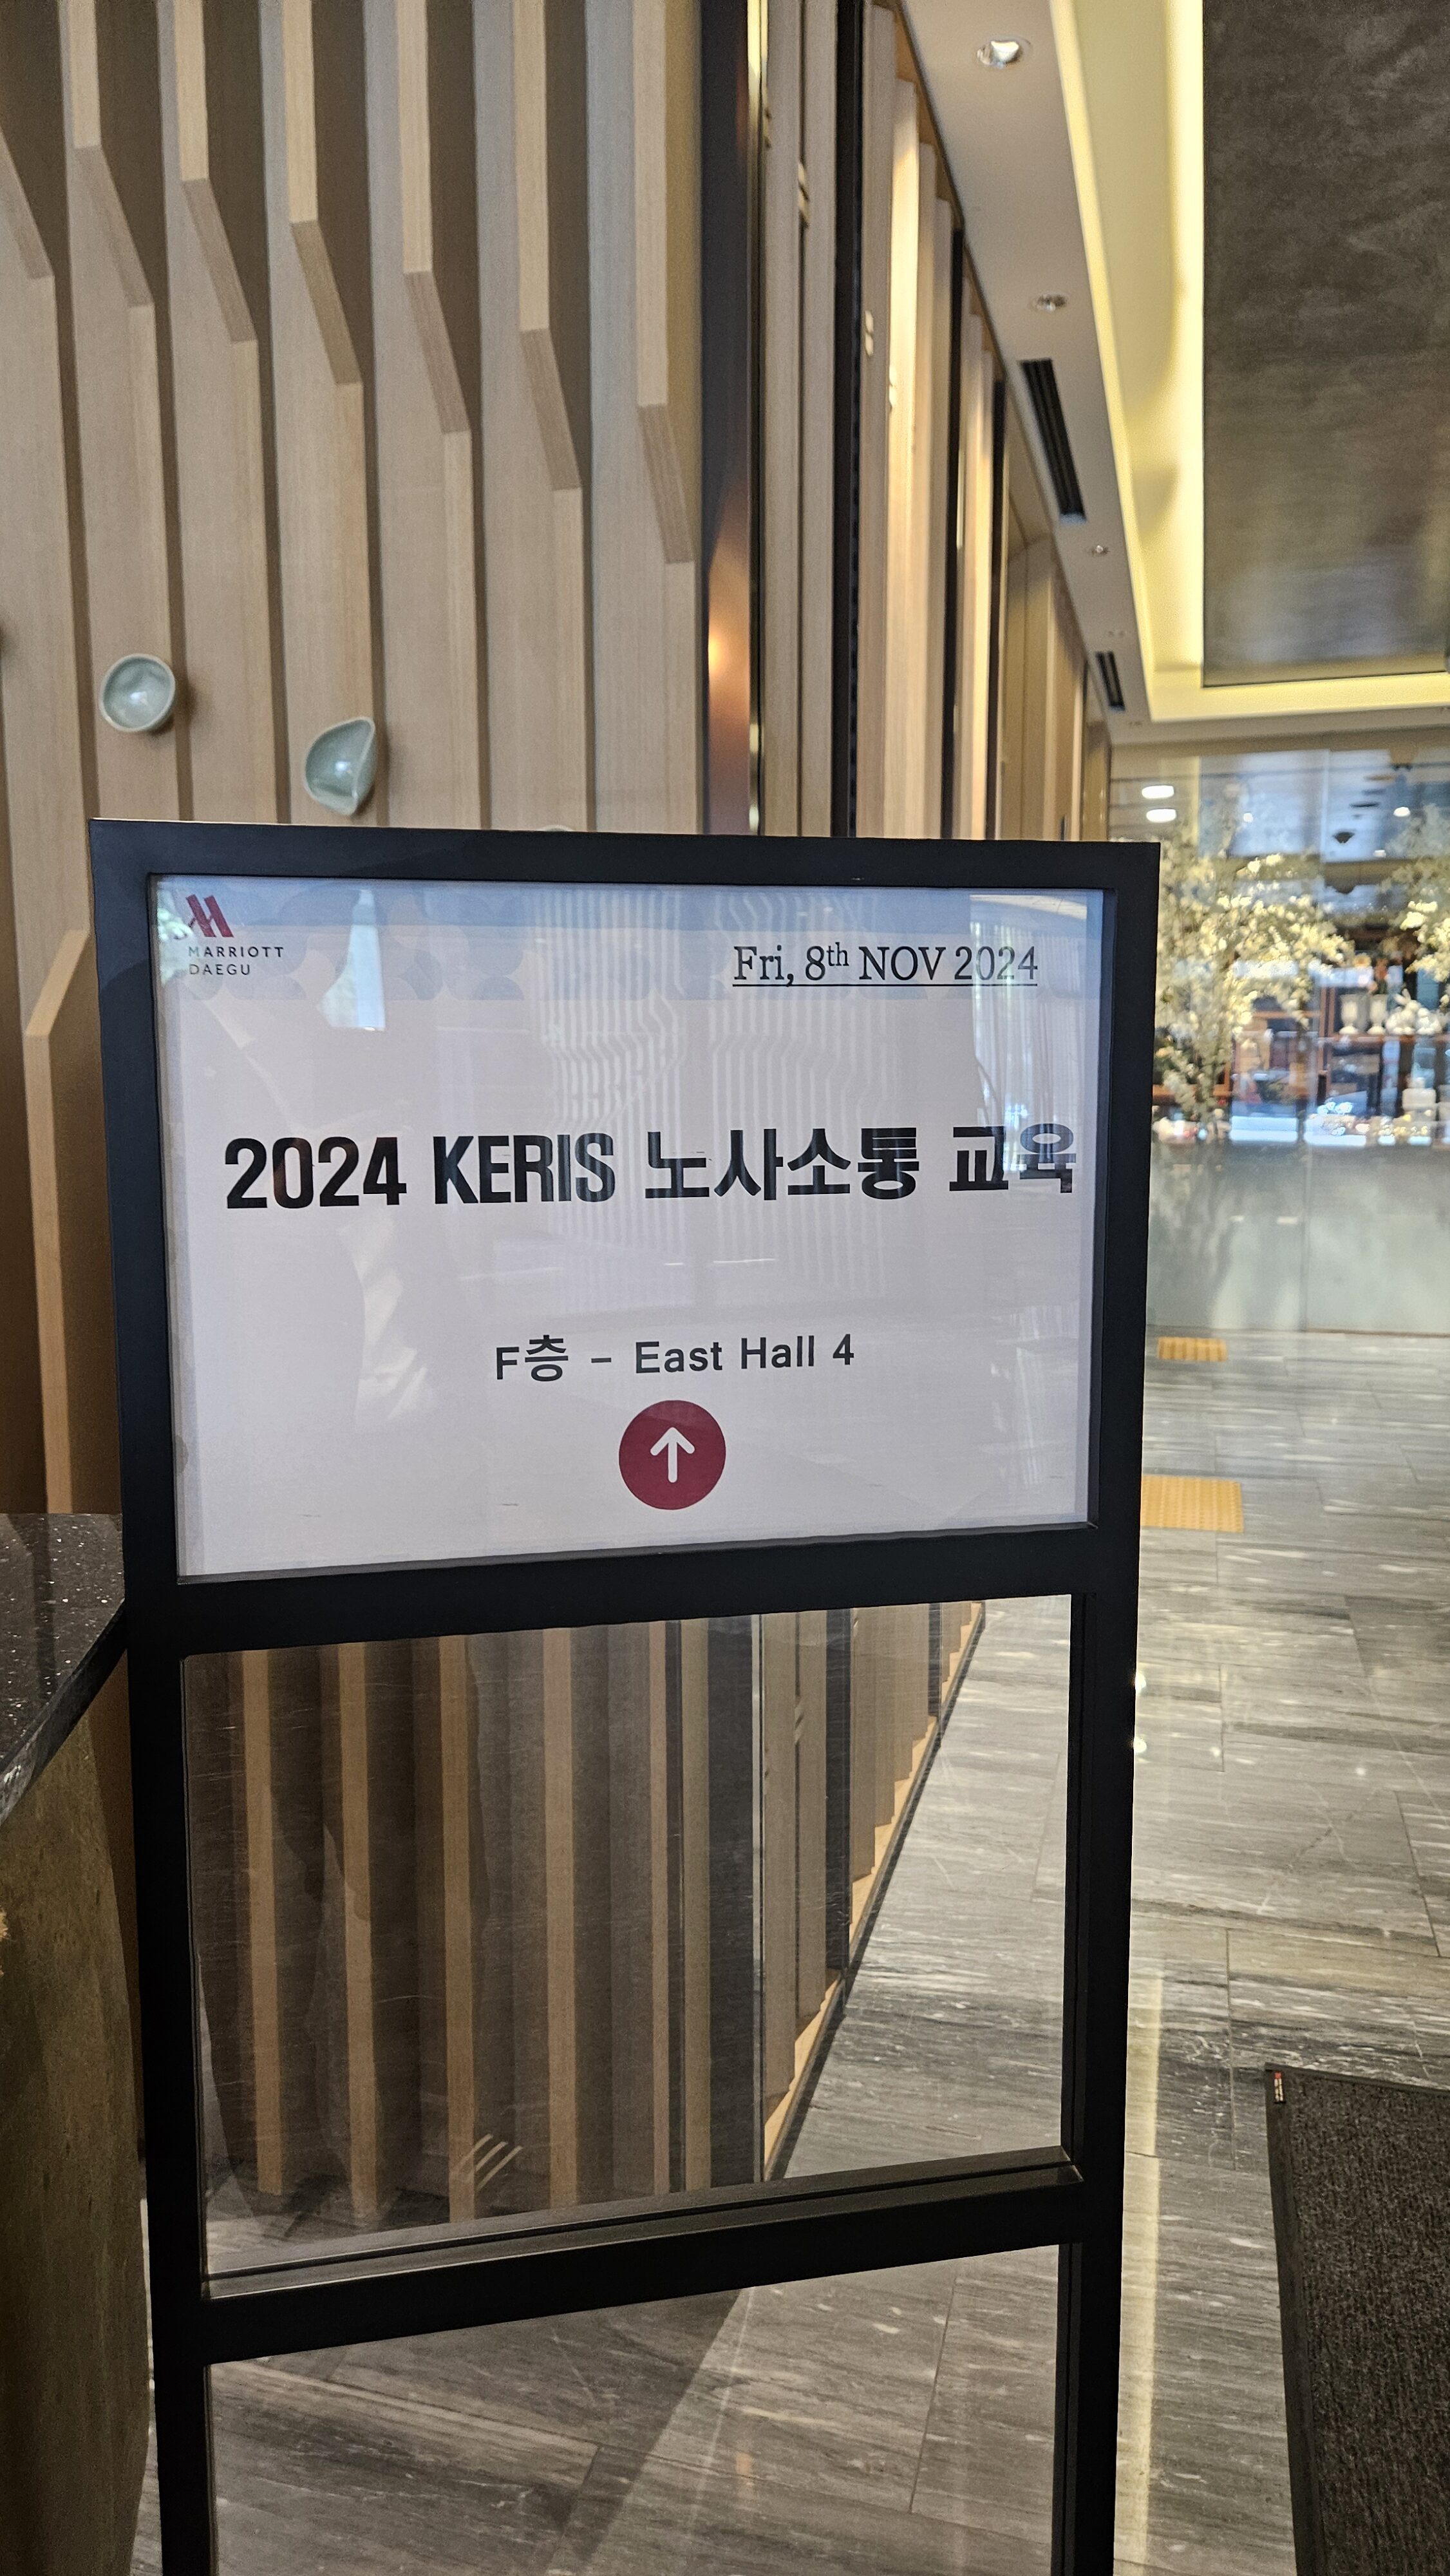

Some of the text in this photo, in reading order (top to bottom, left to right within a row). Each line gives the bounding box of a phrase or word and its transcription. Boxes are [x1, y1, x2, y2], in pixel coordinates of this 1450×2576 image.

[188, 945, 284, 958] MARRIOTT
[189, 963, 250, 976] DAEGU
[733, 942, 1038, 987] Fri, 8th NOV 2024
[225, 1123, 1077, 1209] 2024 KERIS 노사소통 교육
[496, 1334, 569, 1382] F층
[636, 1341, 722, 1374] East
[740, 1335, 814, 1369] Hall
[833, 1334, 854, 1365] 4
